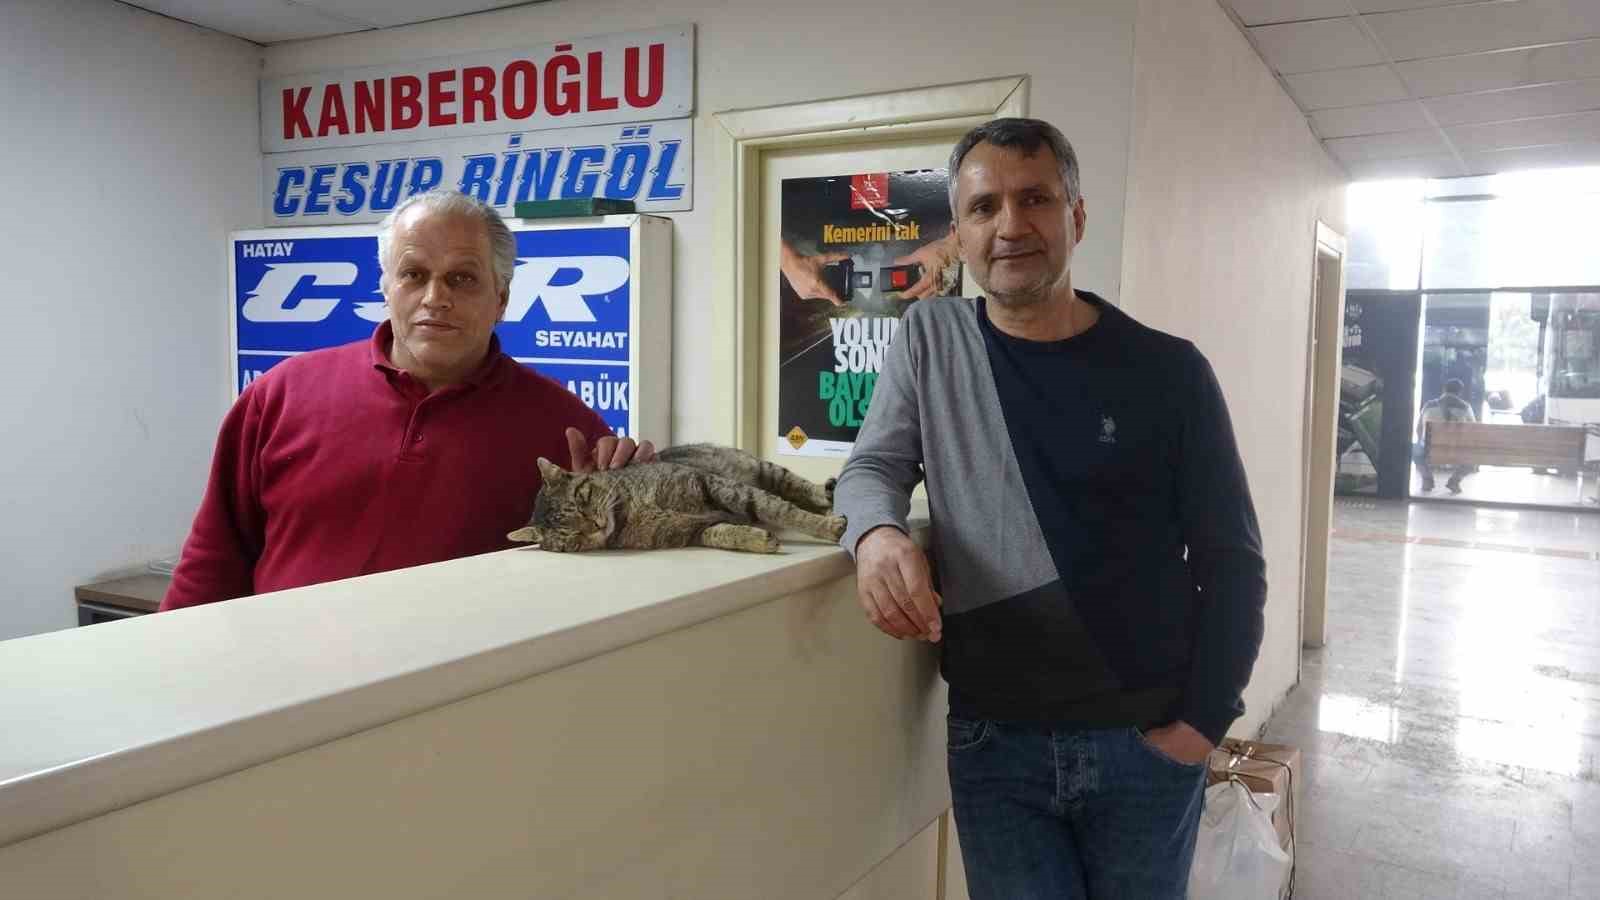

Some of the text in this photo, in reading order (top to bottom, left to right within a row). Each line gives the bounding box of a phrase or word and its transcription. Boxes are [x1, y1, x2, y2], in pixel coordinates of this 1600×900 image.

[282, 43, 666, 140] KANBEROĞLU
[823, 223, 891, 244] Kemerini
[243, 242, 294, 258] HATAY
[242, 255, 630, 323] CR
[535, 330, 628, 349] SEYAHAT
